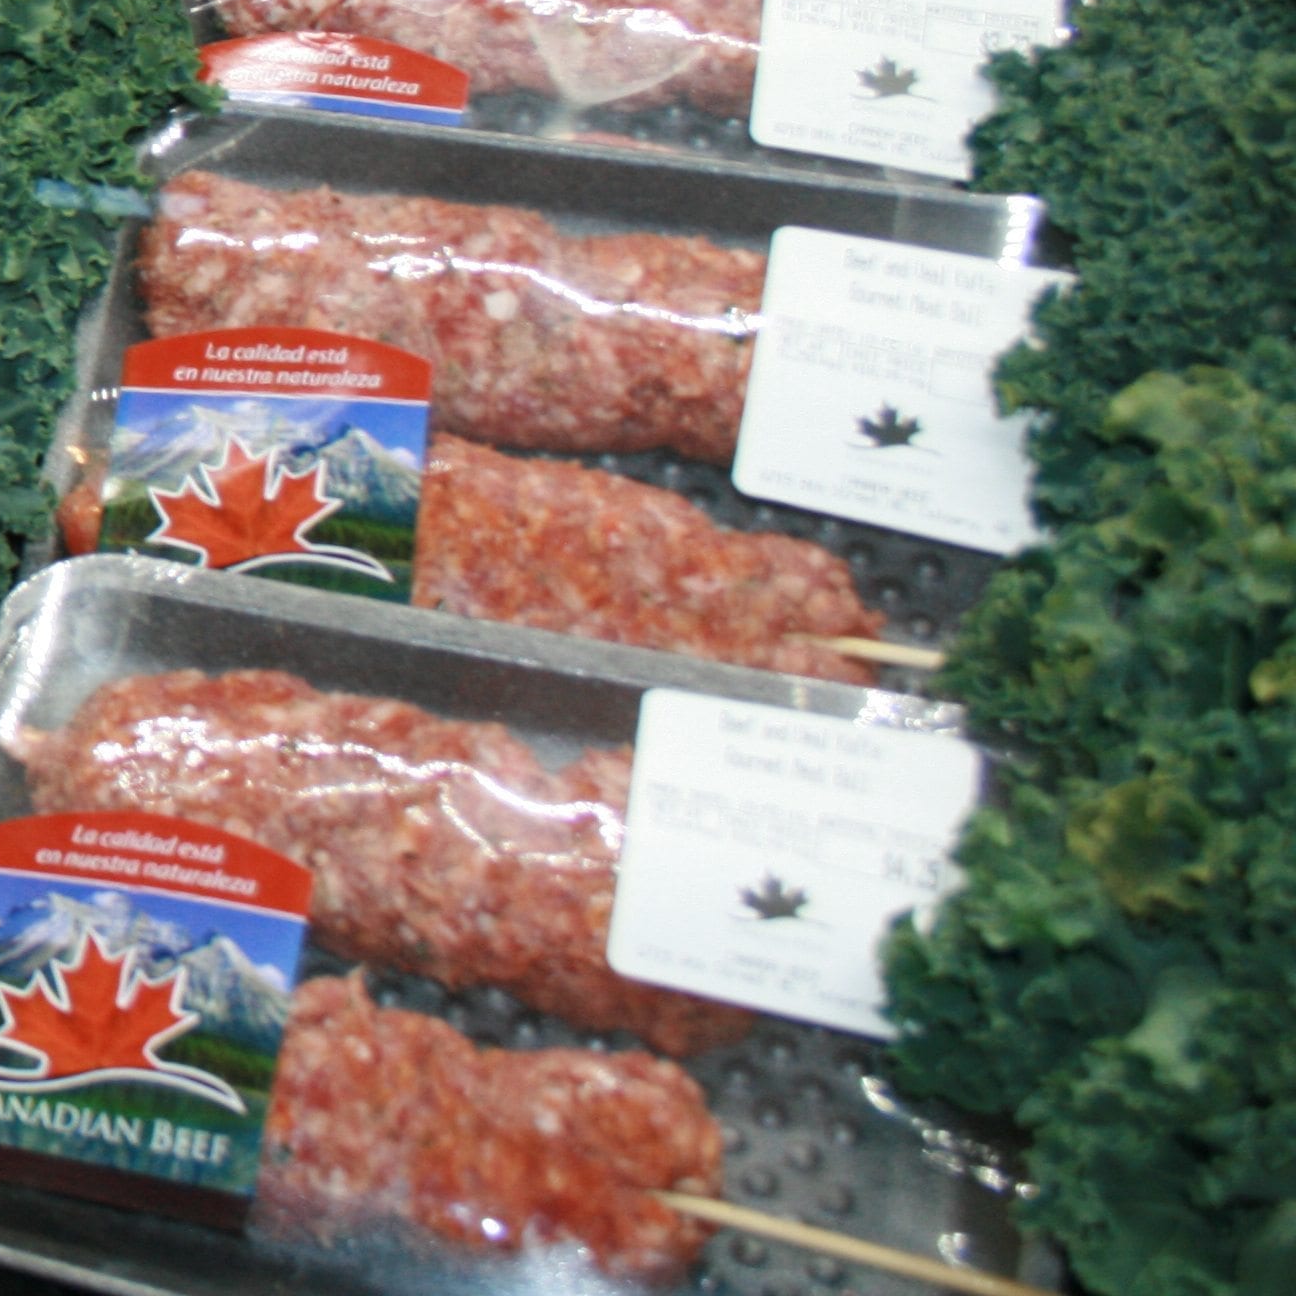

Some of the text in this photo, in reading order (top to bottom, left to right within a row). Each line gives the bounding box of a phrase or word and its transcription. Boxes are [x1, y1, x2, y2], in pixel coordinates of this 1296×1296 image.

[350, 53, 390, 70] está
[320, 71, 421, 95] naturaleza
[205, 342, 348, 365] La calidad está
[173, 364, 382, 388] en nuestra naturaleza
[72, 825, 226, 864] La calidad está
[35, 847, 257, 895] en nuestra naturaleza
[150, 1116, 230, 1164] BEEF
